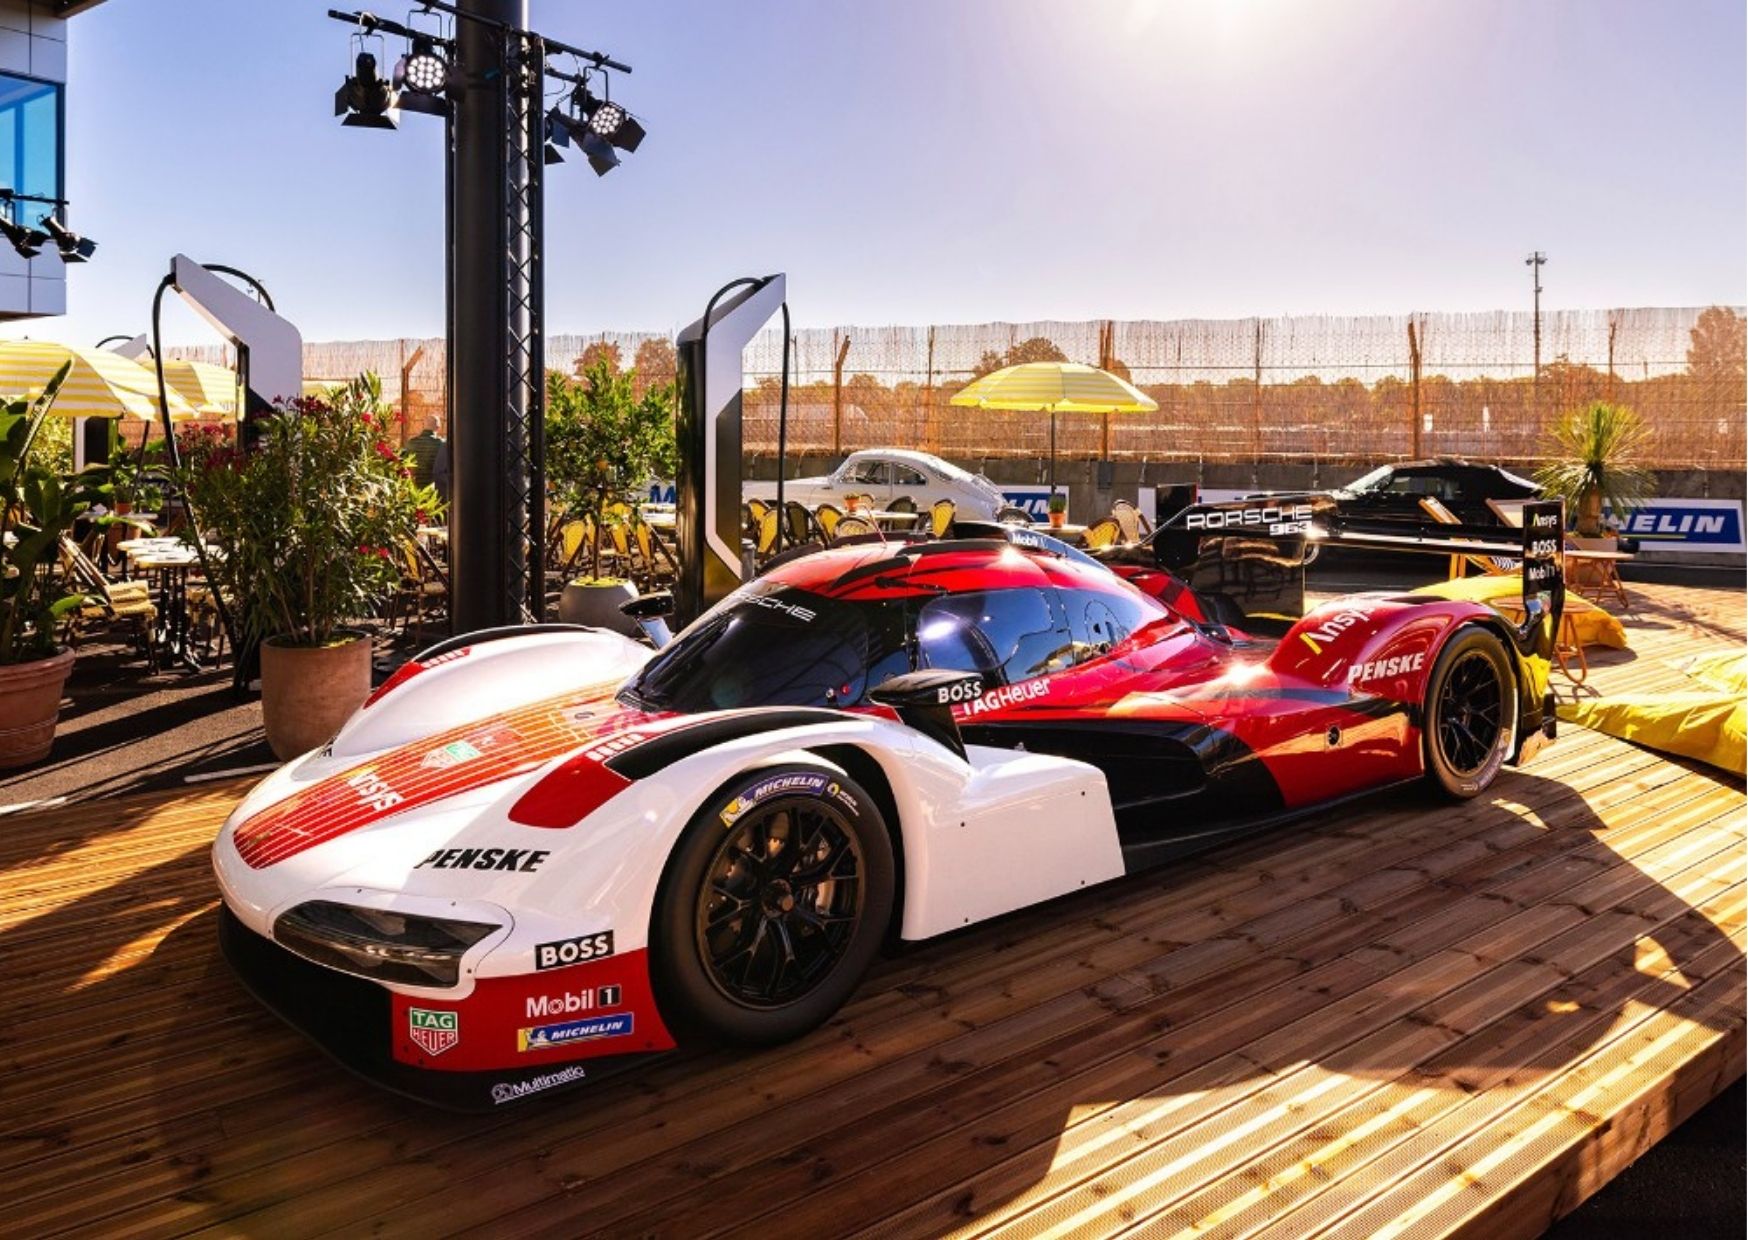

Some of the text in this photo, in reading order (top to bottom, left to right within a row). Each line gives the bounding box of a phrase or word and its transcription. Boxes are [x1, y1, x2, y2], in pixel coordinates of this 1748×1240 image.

[1186, 504, 1313, 531] PORSCHE
[1269, 520, 1314, 536] 963
[1532, 540, 1557, 555] BOSS
[1347, 652, 1425, 684] PENSKE
[937, 681, 982, 704] BOSS
[754, 777, 824, 800] MICHELIN
[412, 848, 552, 873] PENSKE
[540, 935, 609, 967] BOSS
[525, 988, 594, 1018] Mobil
[412, 1011, 454, 1029] TAG
[550, 1020, 624, 1041] MICHELIN
[412, 1028, 455, 1051] HEUER
[512, 1066, 586, 1096] Multimatic
